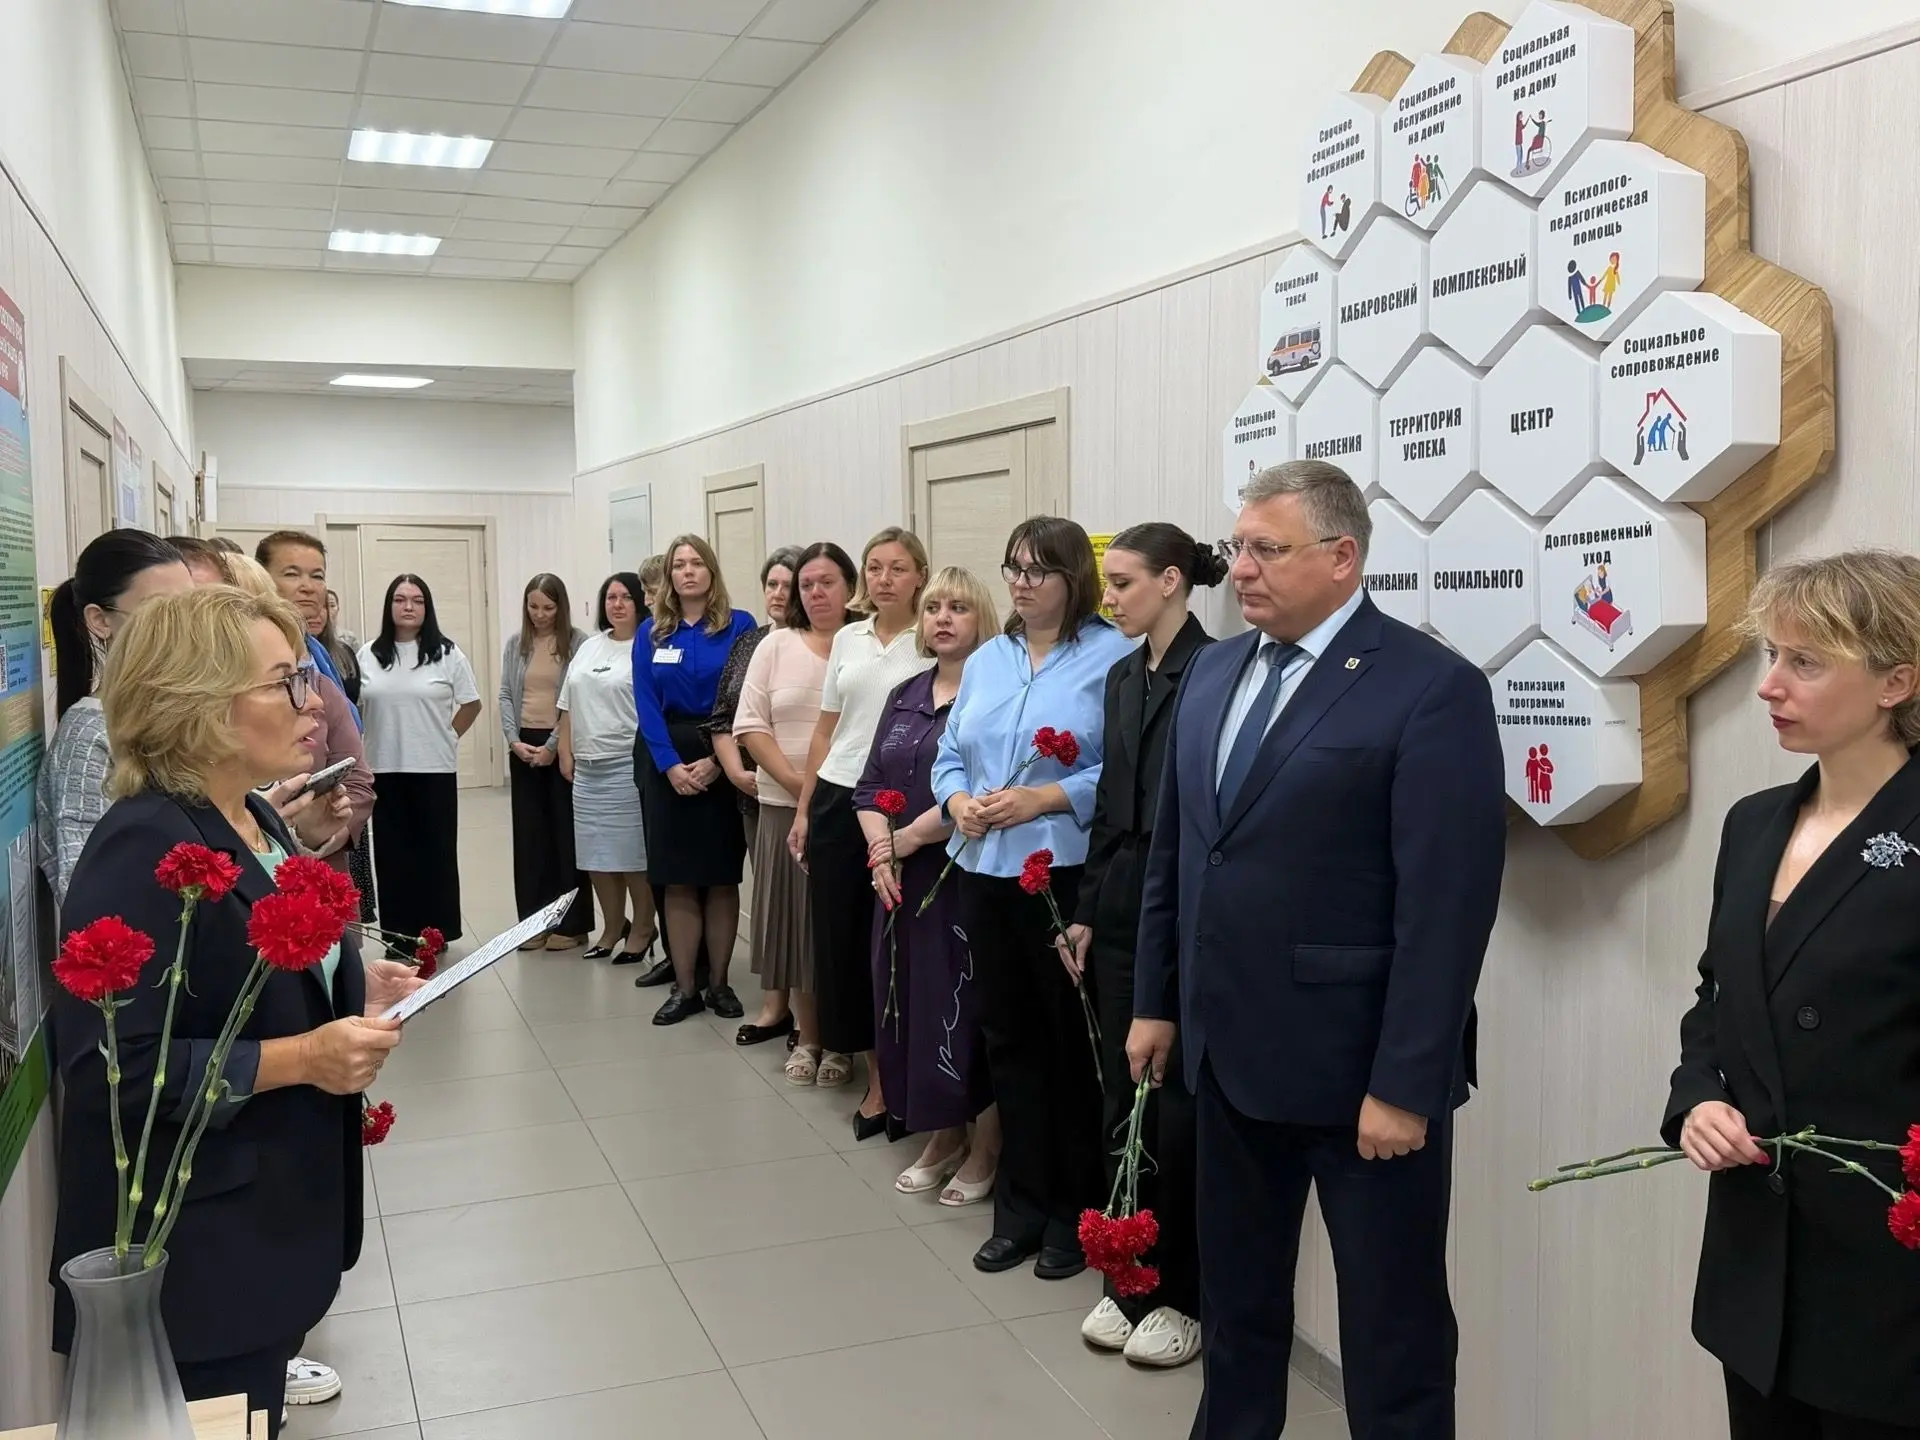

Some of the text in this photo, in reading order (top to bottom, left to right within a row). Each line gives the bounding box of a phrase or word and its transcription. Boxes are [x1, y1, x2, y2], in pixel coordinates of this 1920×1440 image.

[1502, 25, 1570, 65] Социальная
[1496, 44, 1577, 89] реабилитация
[1399, 76, 1456, 112] Социальное
[1513, 73, 1557, 101] на дому
[1393, 93, 1462, 133] обслуживание
[1319, 118, 1352, 143] Срочное
[1408, 120, 1445, 145] на дому
[1312, 133, 1360, 164] социальное
[1307, 148, 1365, 183] обслуживание
[1564, 174, 1632, 206] Психолого-
[1550, 189, 1648, 232] педагогическая
[1573, 220, 1622, 246] помощь
[1274, 271, 1319, 294] Социальное
[1432, 252, 1527, 298] КОМПЛЕКСНЫЙ
[1285, 292, 1307, 307] такси
[1340, 282, 1418, 324] ХАБАРОВСКИЙ
[1624, 327, 1705, 354] Социальное
[1611, 348, 1720, 378] сопровождение
[1235, 409, 1276, 428] Социальное
[1389, 407, 1462, 438] ТЕРРИТОРИЯ
[1510, 406, 1554, 436] ЦЕНТР
[1234, 425, 1277, 444] кураторство
[1305, 434, 1362, 459] НАСЕЛЕНИЯ
[1403, 437, 1446, 461] УСПЕХА
[1544, 521, 1653, 551] Долговременный
[1583, 550, 1612, 567] уход
[1361, 572, 1418, 591] УЖИВАНИЯ
[1434, 569, 1524, 592] СОЦИАЛЬНОГО
[1507, 680, 1566, 692] Реализация
[1509, 698, 1565, 709] программы
[1496, 714, 1532, 725] таршее
